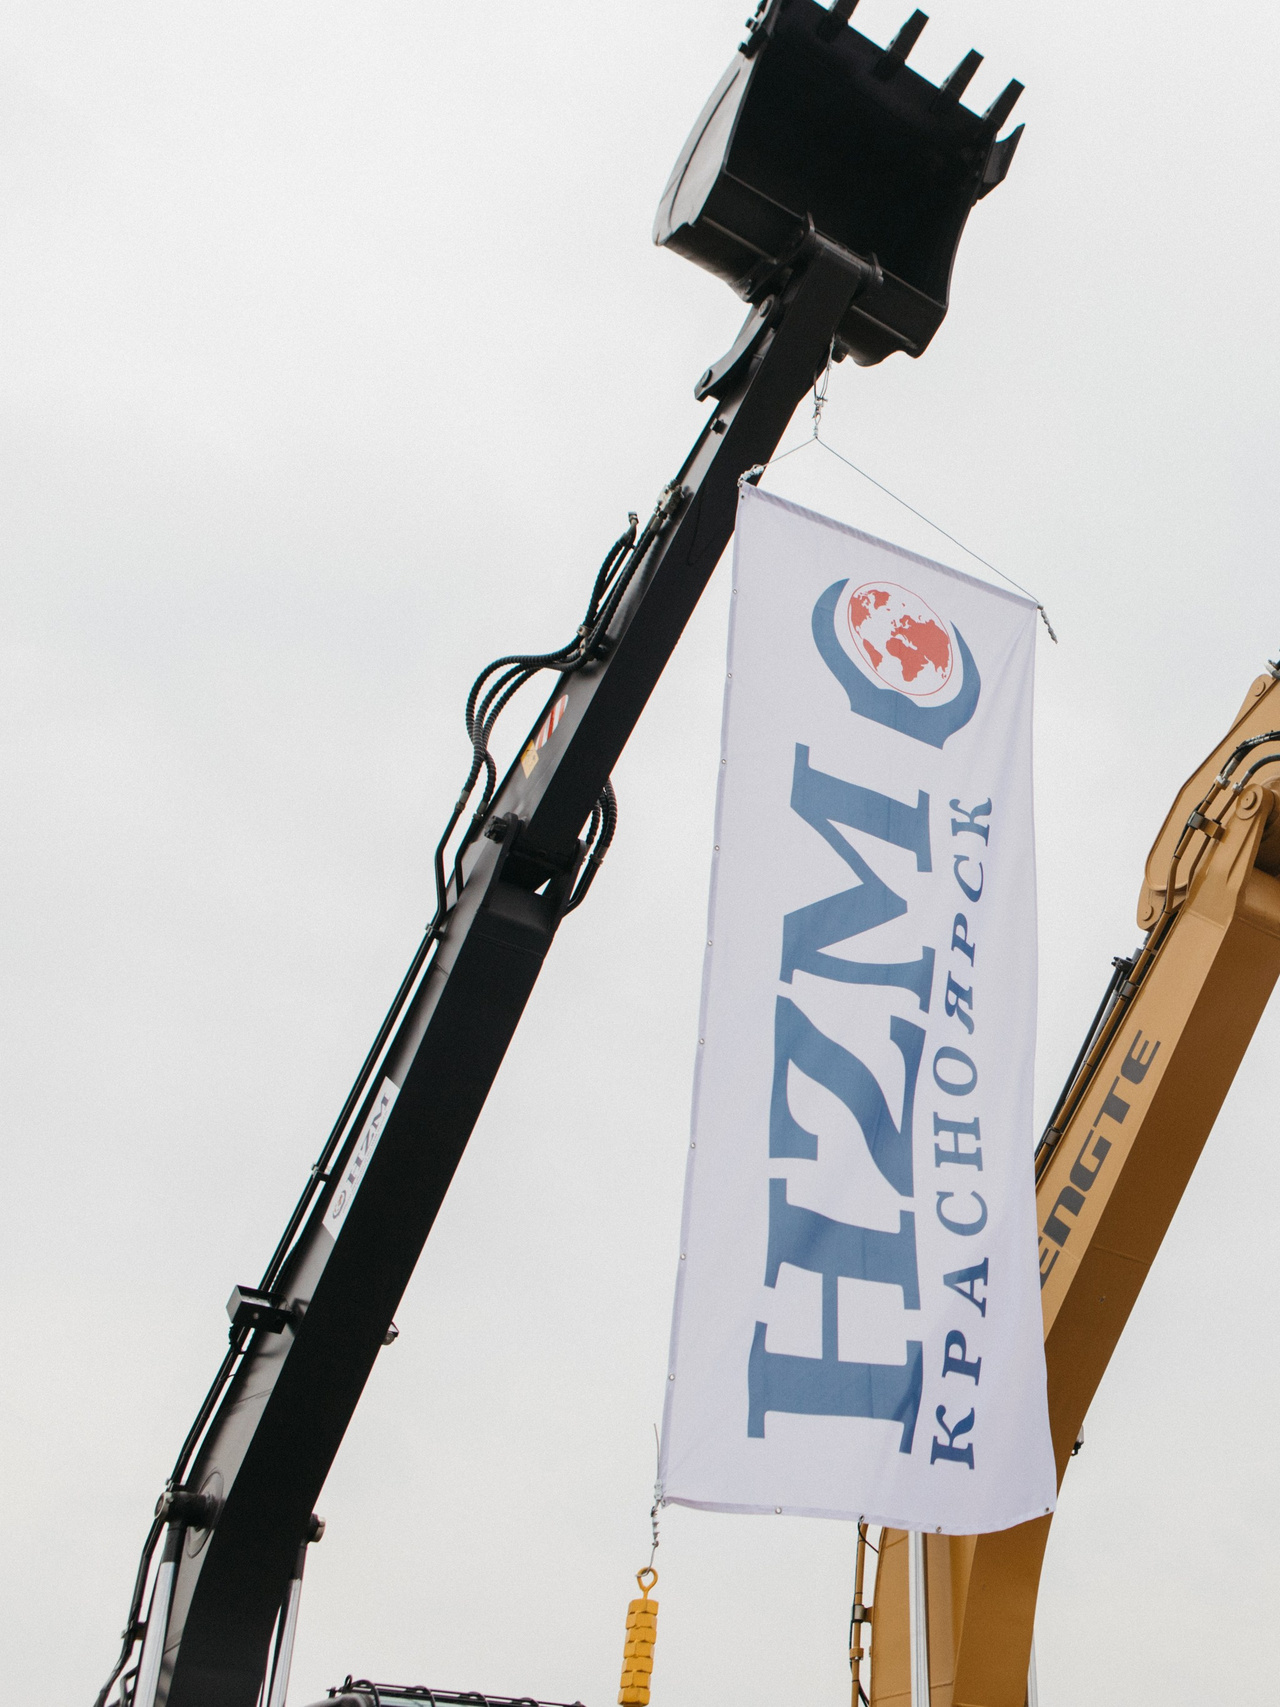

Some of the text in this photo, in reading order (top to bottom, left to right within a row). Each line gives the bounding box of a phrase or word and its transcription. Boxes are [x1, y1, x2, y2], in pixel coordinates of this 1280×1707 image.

[346, 1092, 390, 1187] HZM
[746, 741, 936, 1455] HZM
[929, 797, 994, 1471] КРАСНОЯРСК
[1039, 1030, 1161, 1292] ENGTE
